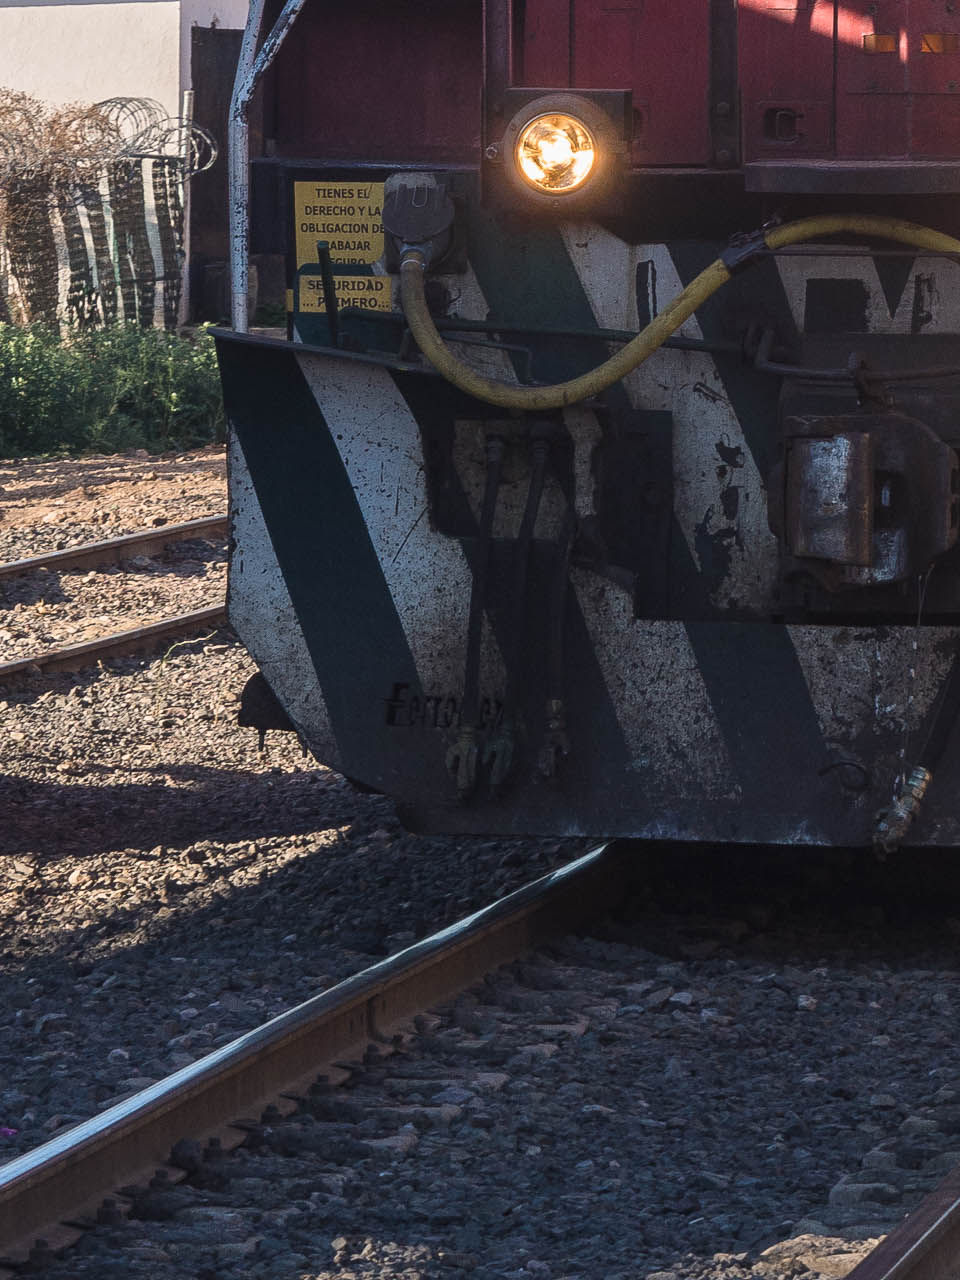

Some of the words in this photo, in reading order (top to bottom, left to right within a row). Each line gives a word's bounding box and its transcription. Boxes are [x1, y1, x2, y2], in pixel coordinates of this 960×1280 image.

[315, 188, 354, 199] TIENES
[357, 188, 370, 199] EL
[304, 206, 355, 216] DERECHO
[358, 206, 366, 216] Y
[368, 206, 382, 216] LA
[300, 223, 369, 234] OBLIGACION
[371, 223, 385, 234] DE
[326, 241, 371, 252] ABAJAR
[307, 280, 384, 292] SEURIDAD
[317, 297, 390, 309] PIMERO...
